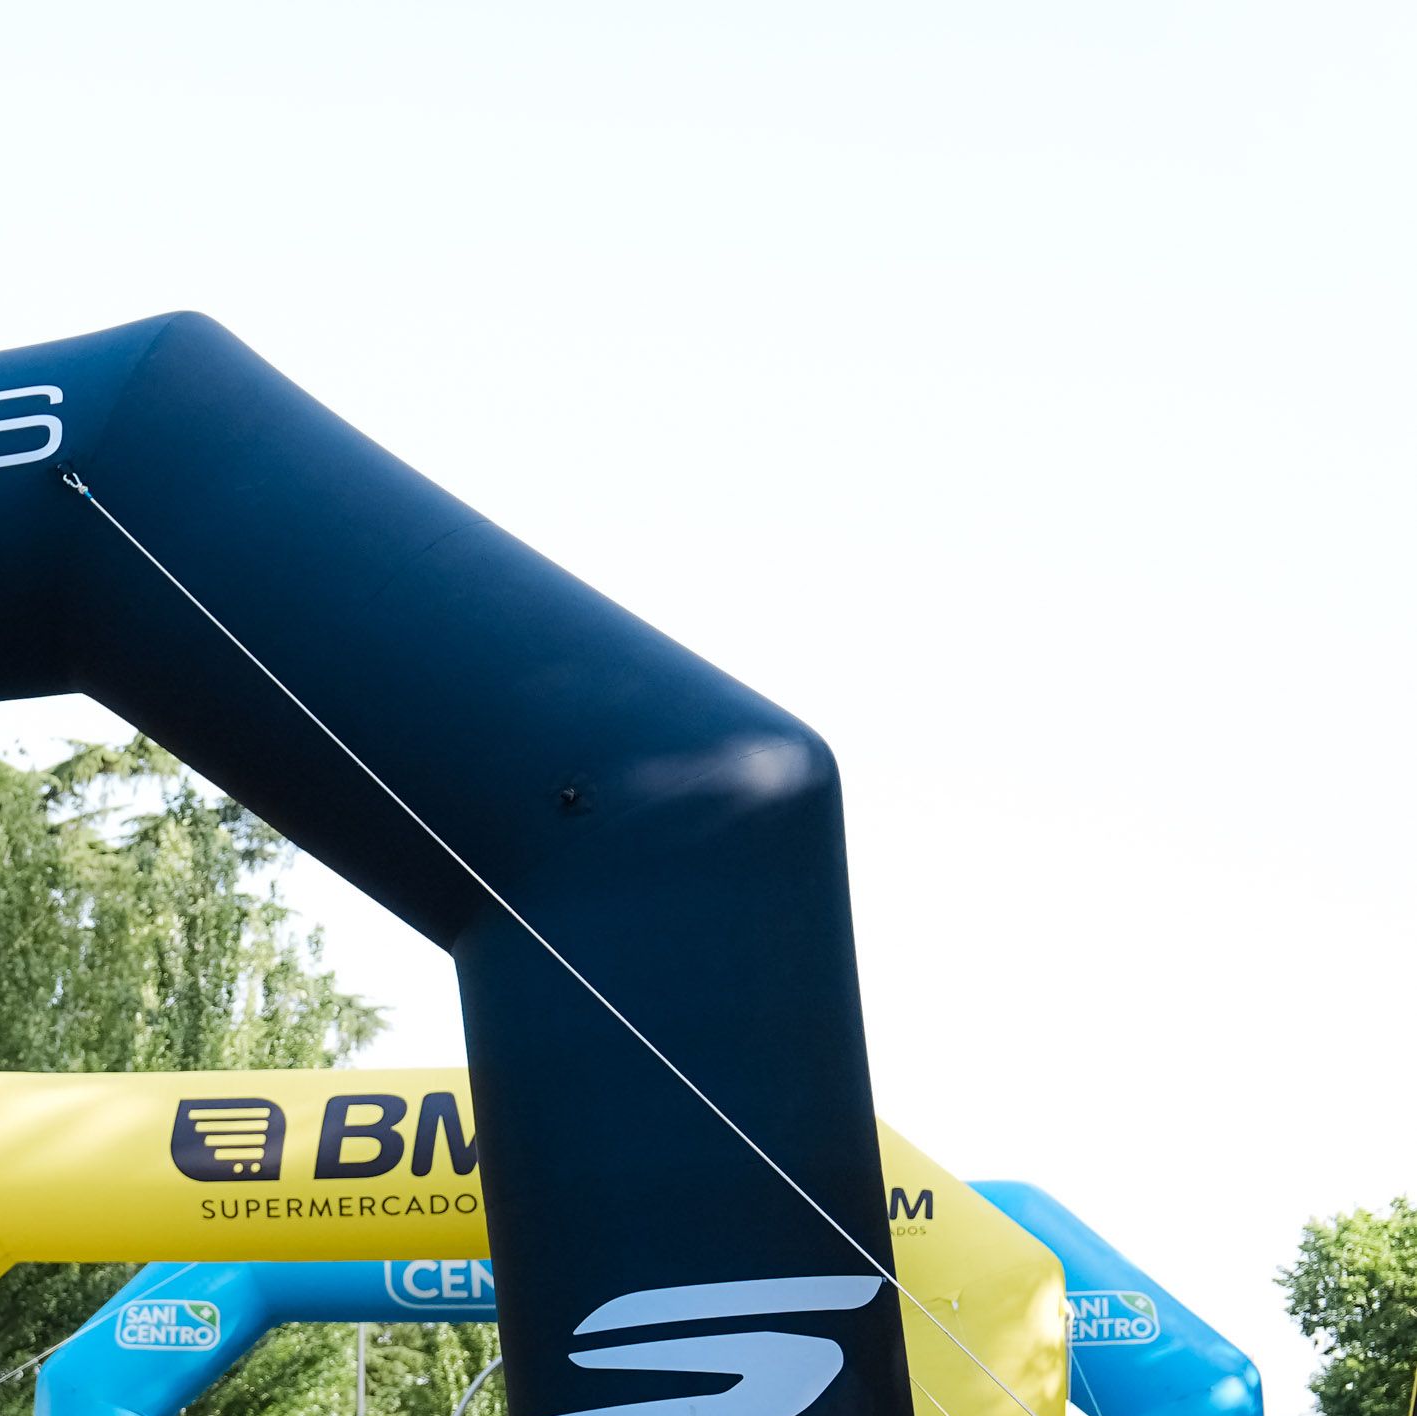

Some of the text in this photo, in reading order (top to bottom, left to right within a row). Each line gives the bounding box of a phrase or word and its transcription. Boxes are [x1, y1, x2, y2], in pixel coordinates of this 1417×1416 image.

[201, 1193, 478, 1220] SUPERMERCADO
[889, 1187, 933, 1220] M
[402, 1259, 495, 1299] CEN
[126, 1305, 177, 1325] SANI
[1069, 1297, 1109, 1319] ANI
[122, 1325, 214, 1345] CENTRO
[1071, 1317, 1153, 1339] ENTRO
